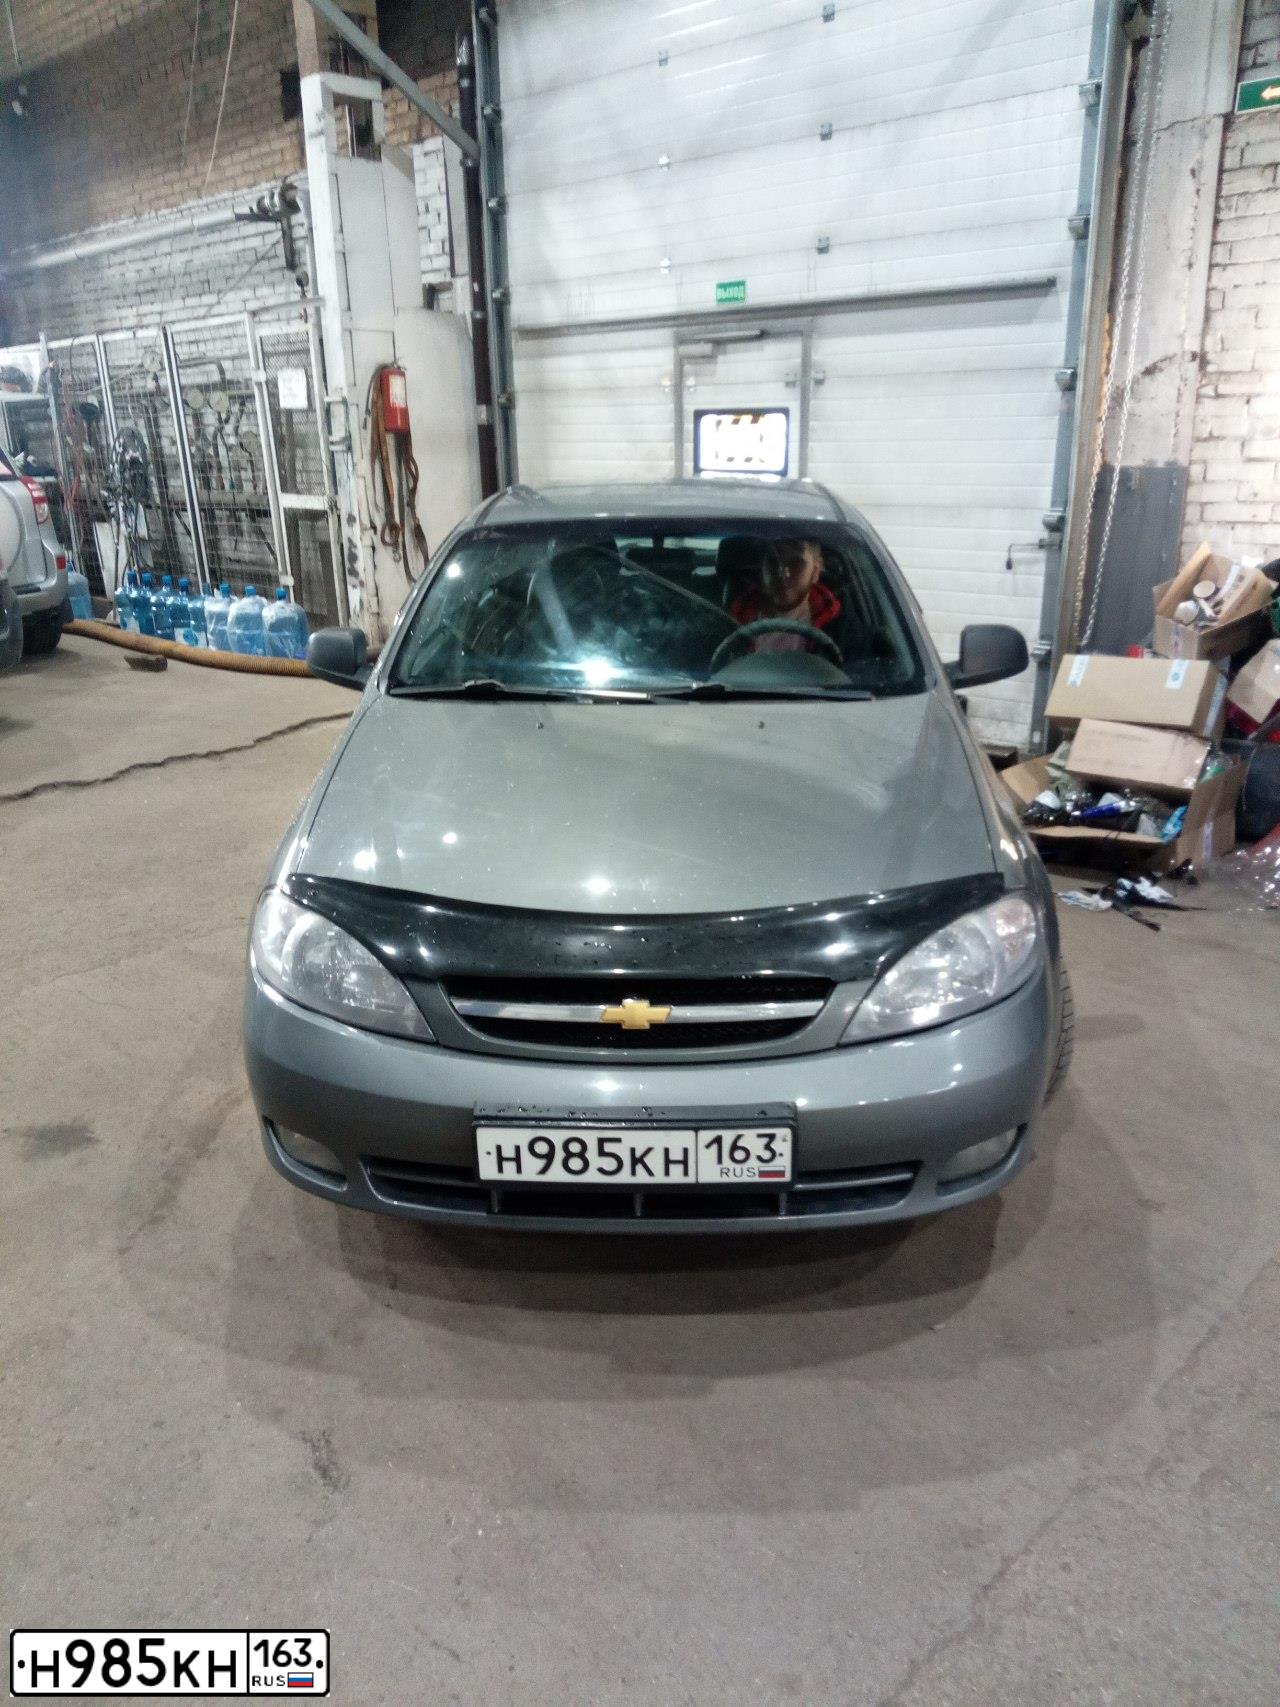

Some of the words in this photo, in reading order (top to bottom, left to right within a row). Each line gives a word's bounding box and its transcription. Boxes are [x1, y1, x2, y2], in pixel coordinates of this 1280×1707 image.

[495, 1135, 689, 1178] Н985КН
[704, 1133, 778, 1166] 163
[719, 1166, 757, 1179] RUS
